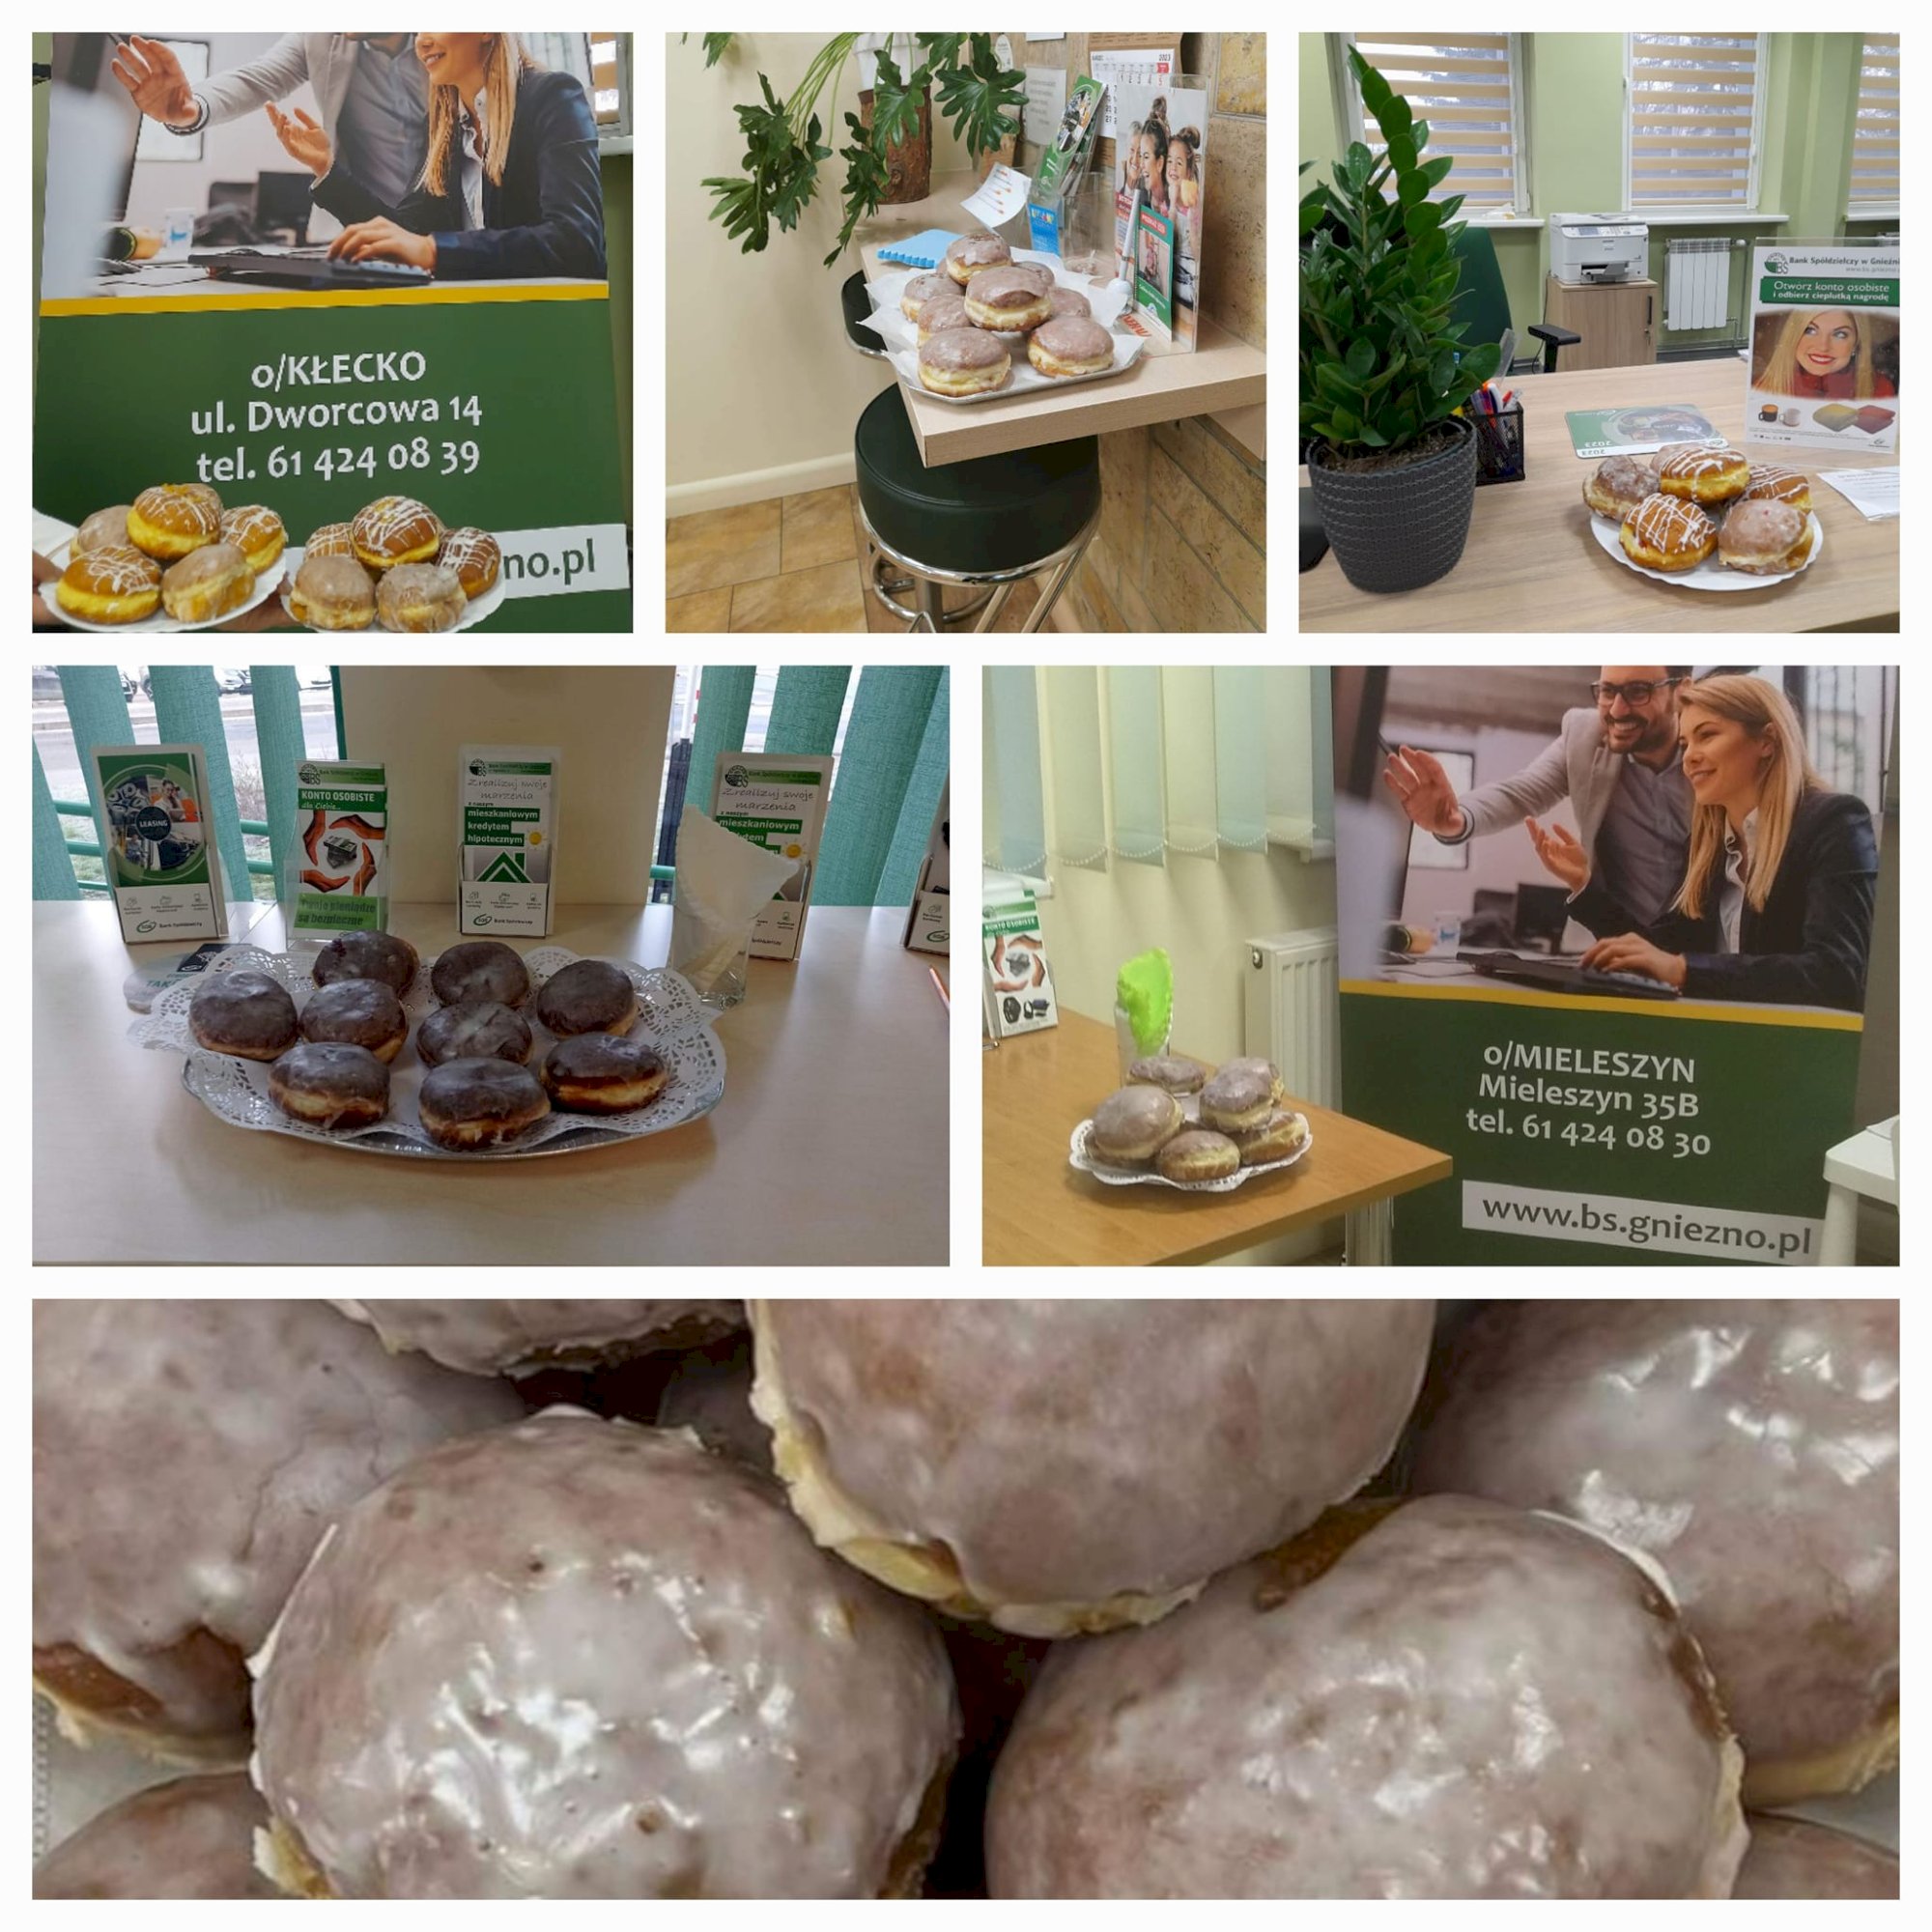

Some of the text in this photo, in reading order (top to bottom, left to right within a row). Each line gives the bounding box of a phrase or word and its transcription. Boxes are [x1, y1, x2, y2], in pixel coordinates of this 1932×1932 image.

[1810, 257, 1859, 266] Spółdzielczy
[1774, 280, 1889, 293] Otwórz konto osobiste
[1812, 292, 1851, 300] cieplutką
[1854, 294, 1889, 302] nagrodę
[251, 351, 426, 391] o/KŁECKO
[191, 394, 482, 435] ul. Dworcowa 14
[197, 438, 480, 483] tel. 61 424 08 39
[503, 537, 595, 585] no.pl
[468, 779, 548, 790] Zrealizuj swoje
[301, 790, 375, 803] KONTO OSOBISTE
[722, 788, 814, 802] Zrealizuj swoje
[735, 802, 797, 811] marzenia
[468, 809, 538, 821] mieszkaniowym
[139, 819, 168, 828] LEASING
[468, 821, 510, 832] kredytem
[719, 819, 800, 832] mieszkaniowym
[468, 835, 524, 844] hipotecznym
[1483, 1040, 1695, 1084] o/MIELESZYN
[1478, 1073, 1699, 1121] Mieleszyn 35B
[1466, 1108, 1712, 1158] tel. 61 424 08 30
[1482, 1198, 1811, 1258] www.bs.gniezno.pl
